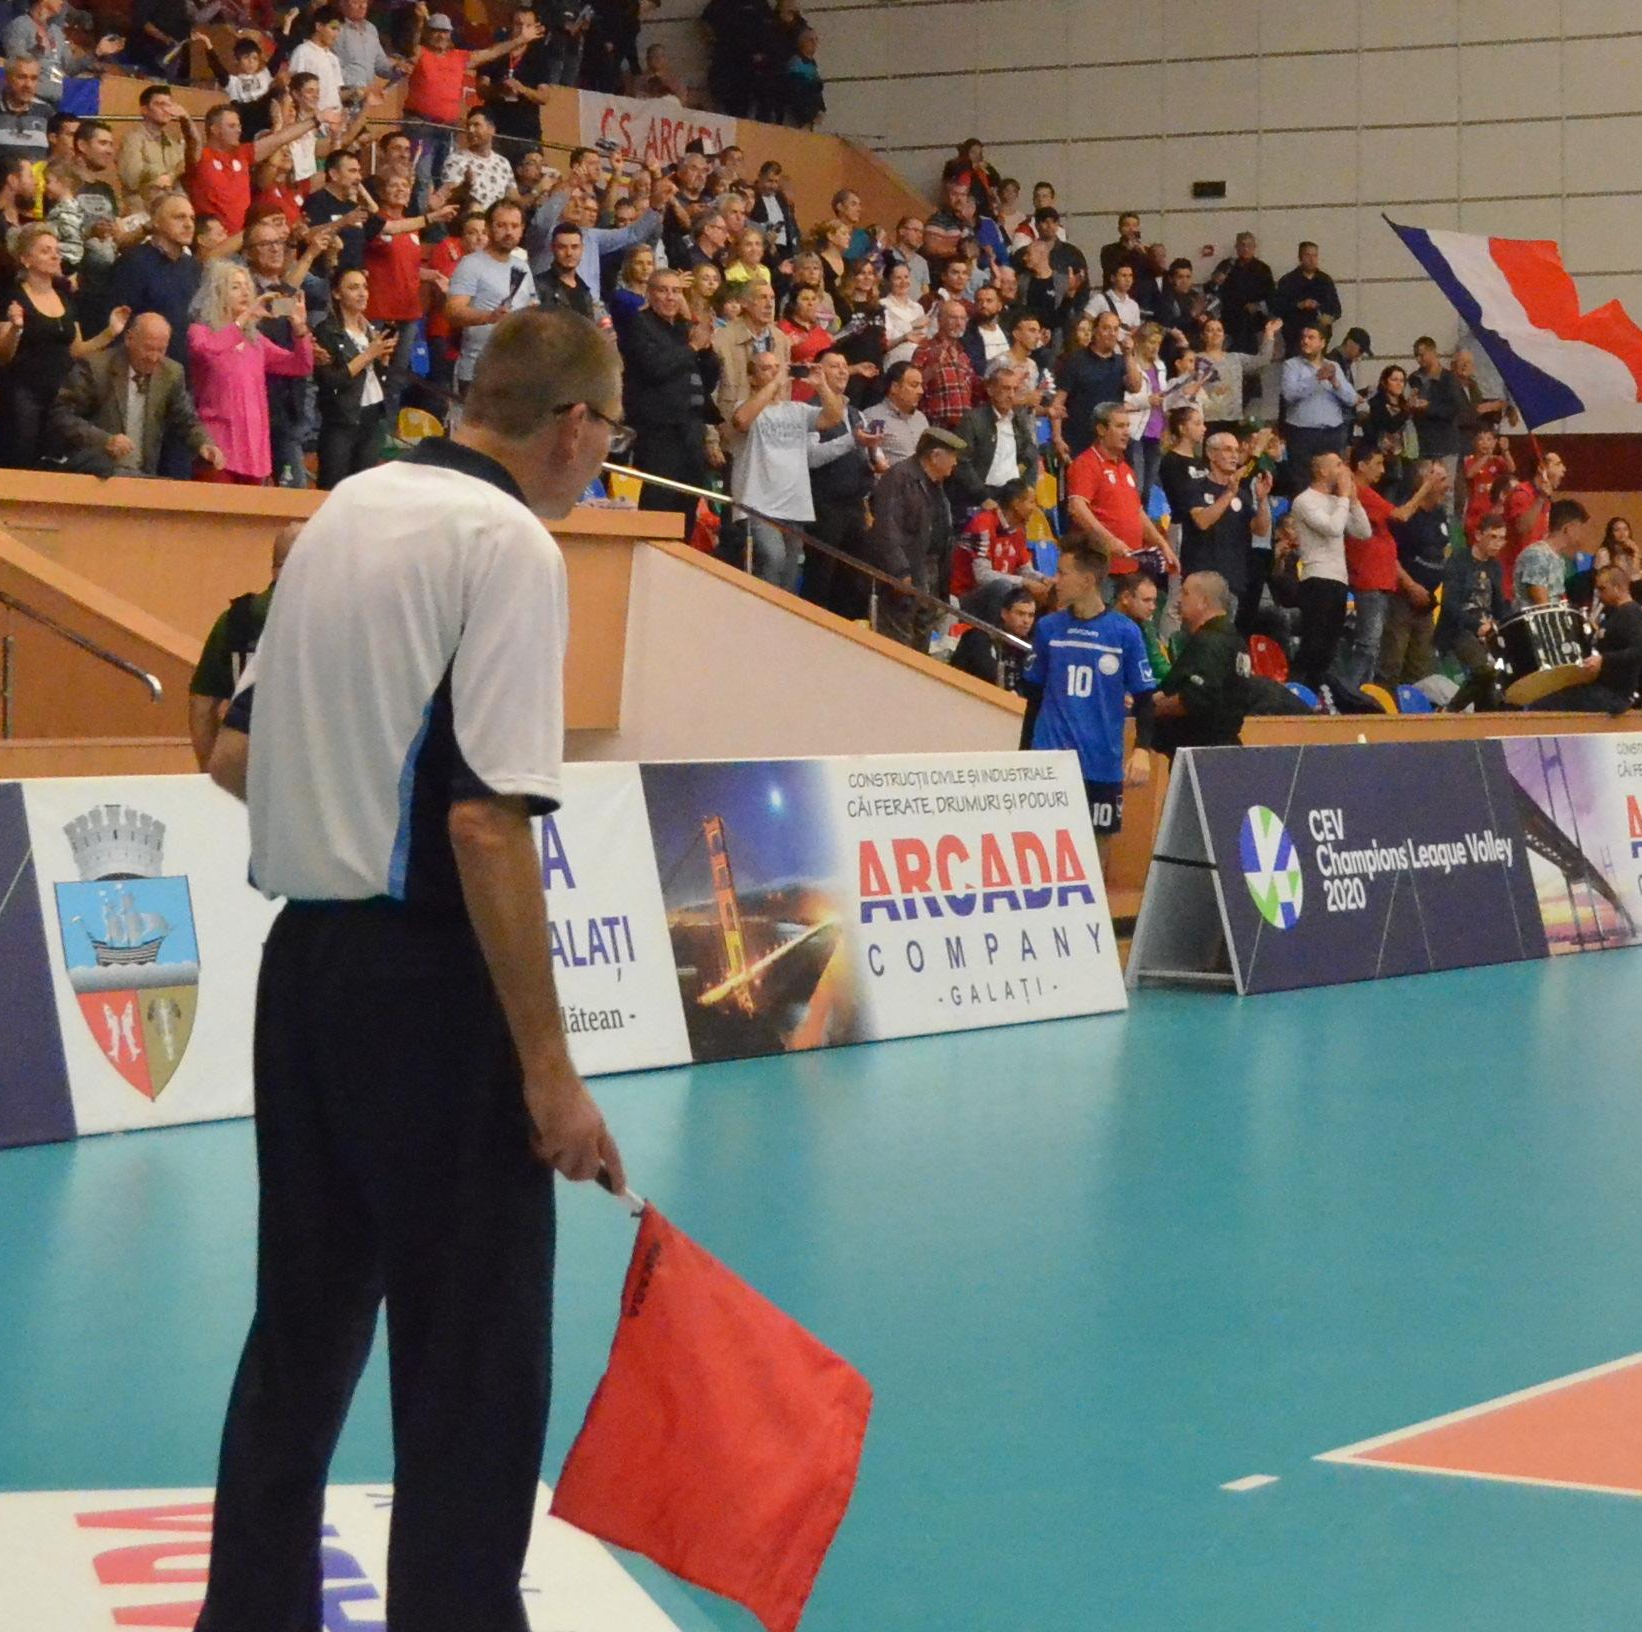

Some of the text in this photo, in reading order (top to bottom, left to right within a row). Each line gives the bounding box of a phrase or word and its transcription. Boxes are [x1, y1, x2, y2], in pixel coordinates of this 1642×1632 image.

[1066, 665, 1094, 698] 10
[937, 793, 1000, 813] DRUMURI
[1019, 791, 1069, 809] PODURI
[1093, 803, 1112, 826] 10
[1308, 808, 1345, 842] CEV
[1316, 830, 1513, 881] Champions League Volley
[860, 829, 1096, 924] ARCADA
[1323, 877, 1367, 912] 2020
[548, 915, 635, 982] ALAȚI
[868, 923, 1101, 976] COMPANY
[560, 1005, 624, 1033] lătean
